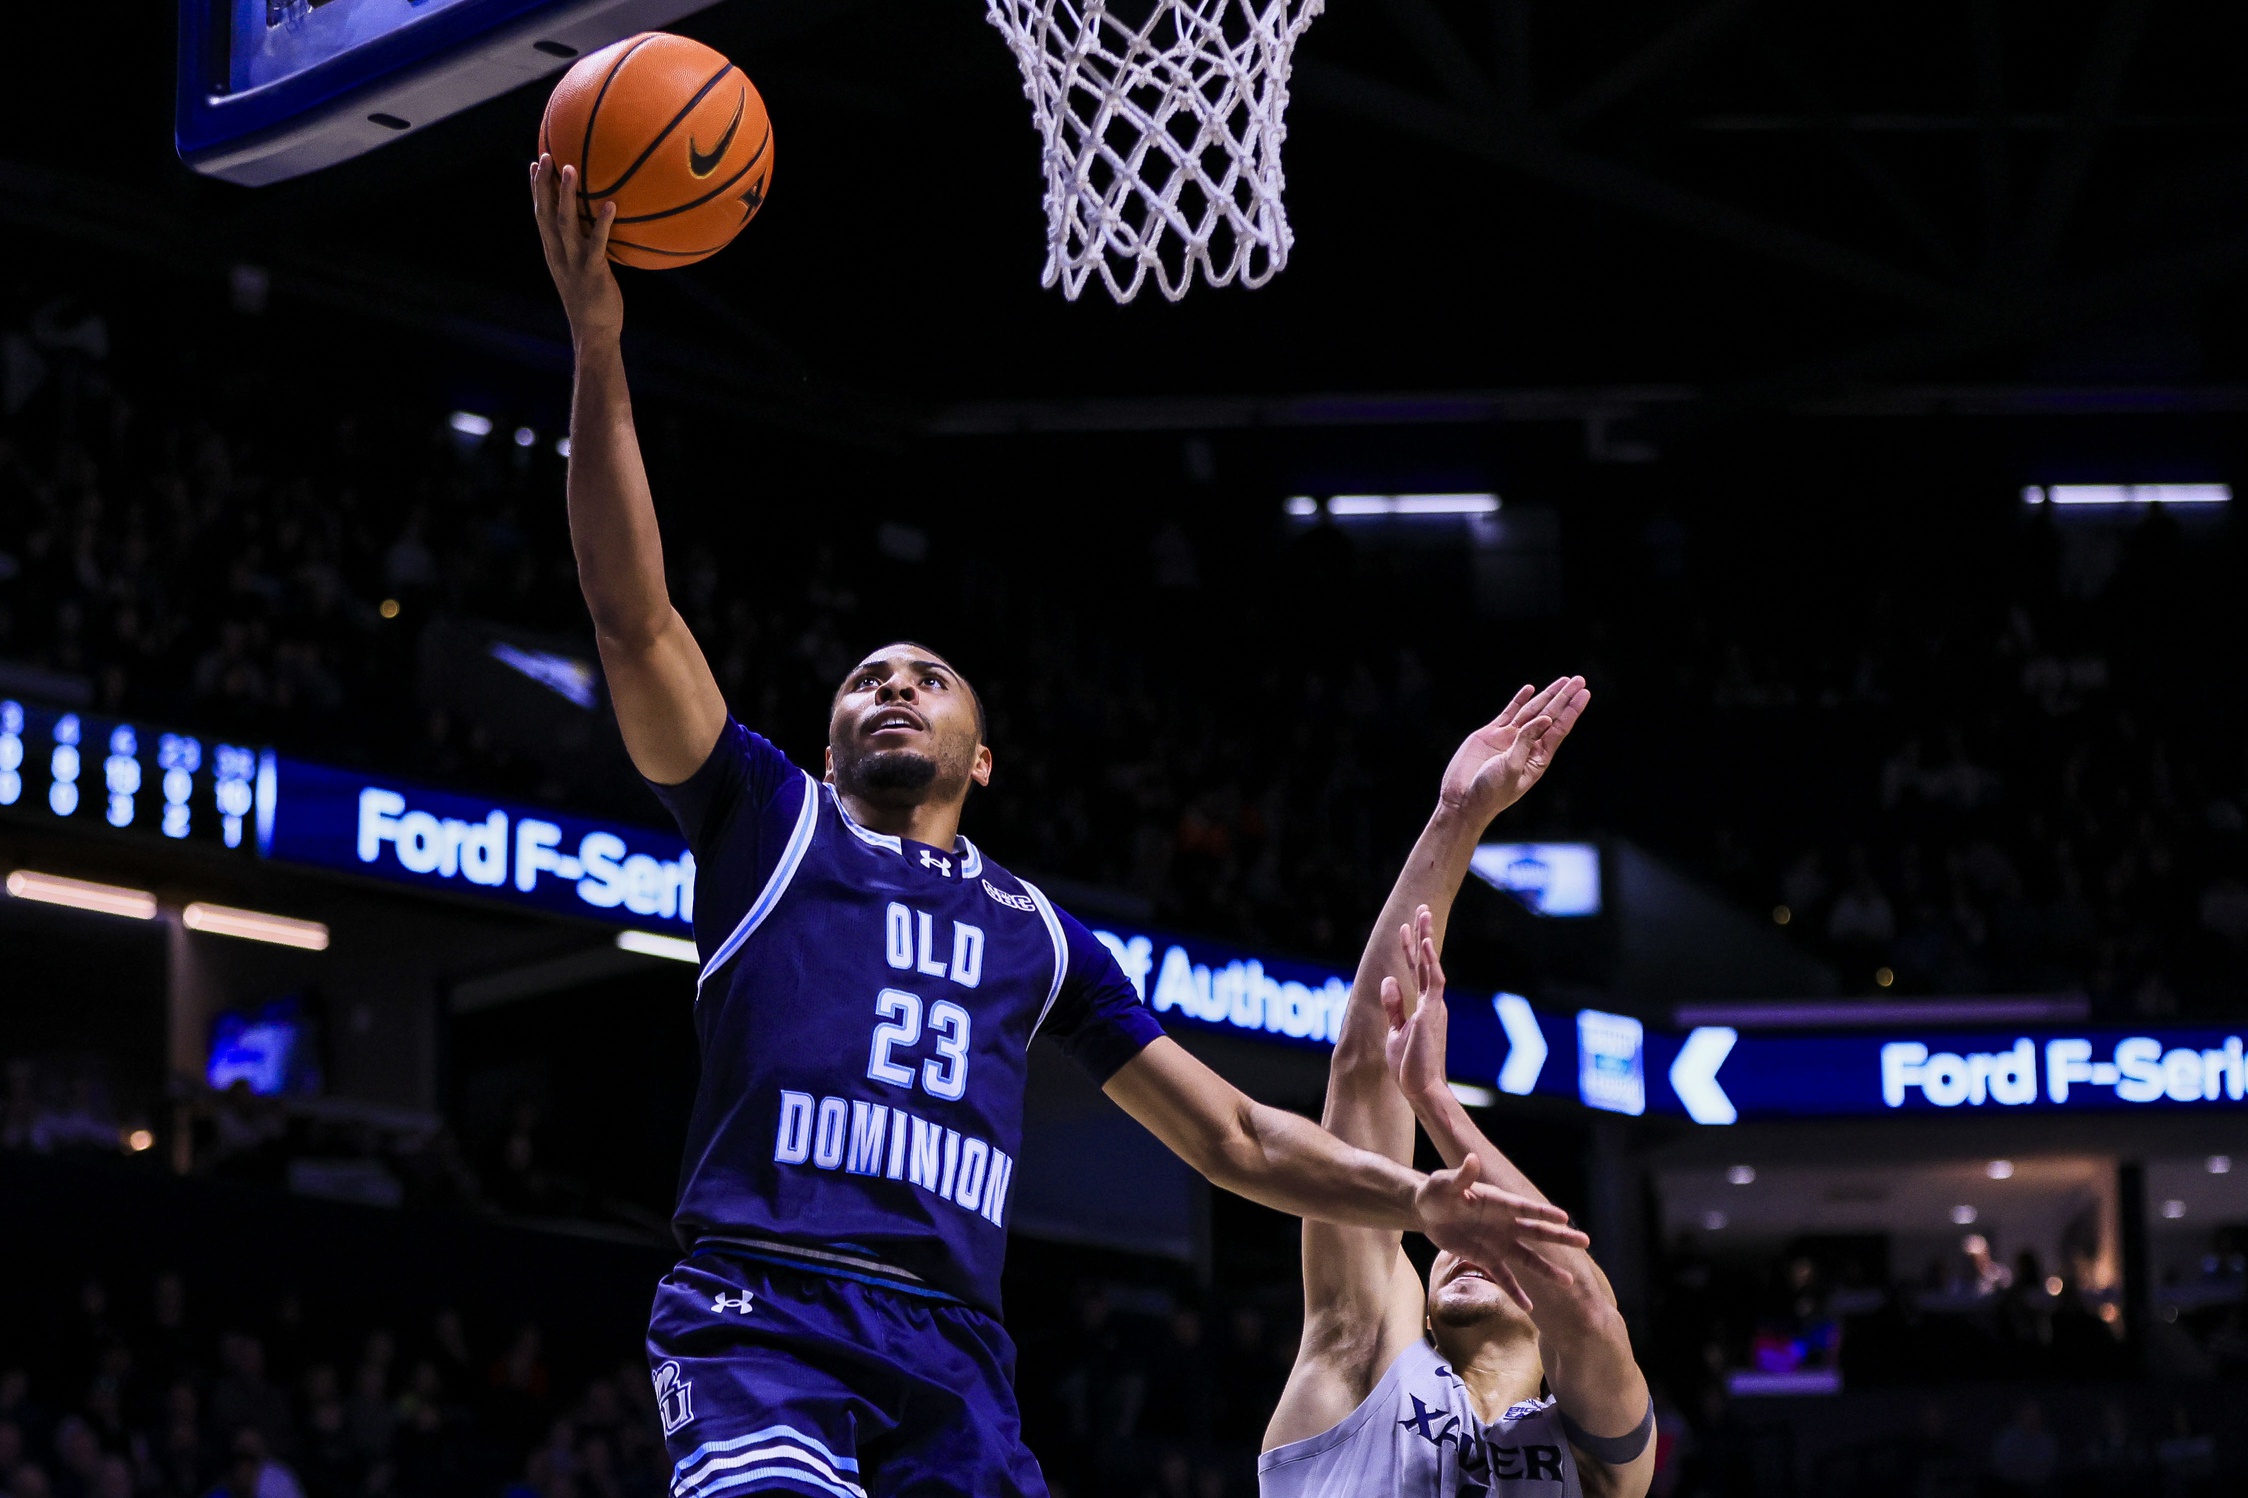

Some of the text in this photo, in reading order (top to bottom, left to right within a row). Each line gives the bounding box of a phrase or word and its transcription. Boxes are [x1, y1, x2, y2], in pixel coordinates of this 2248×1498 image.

[357, 787, 507, 888] Ford
[886, 901, 985, 989] OLD
[1152, 945, 1354, 1045] Authori
[867, 987, 971, 1102] 23
[1881, 1035, 2248, 1108] Ford F-Seri
[774, 1089, 1014, 1229] DOMINION
